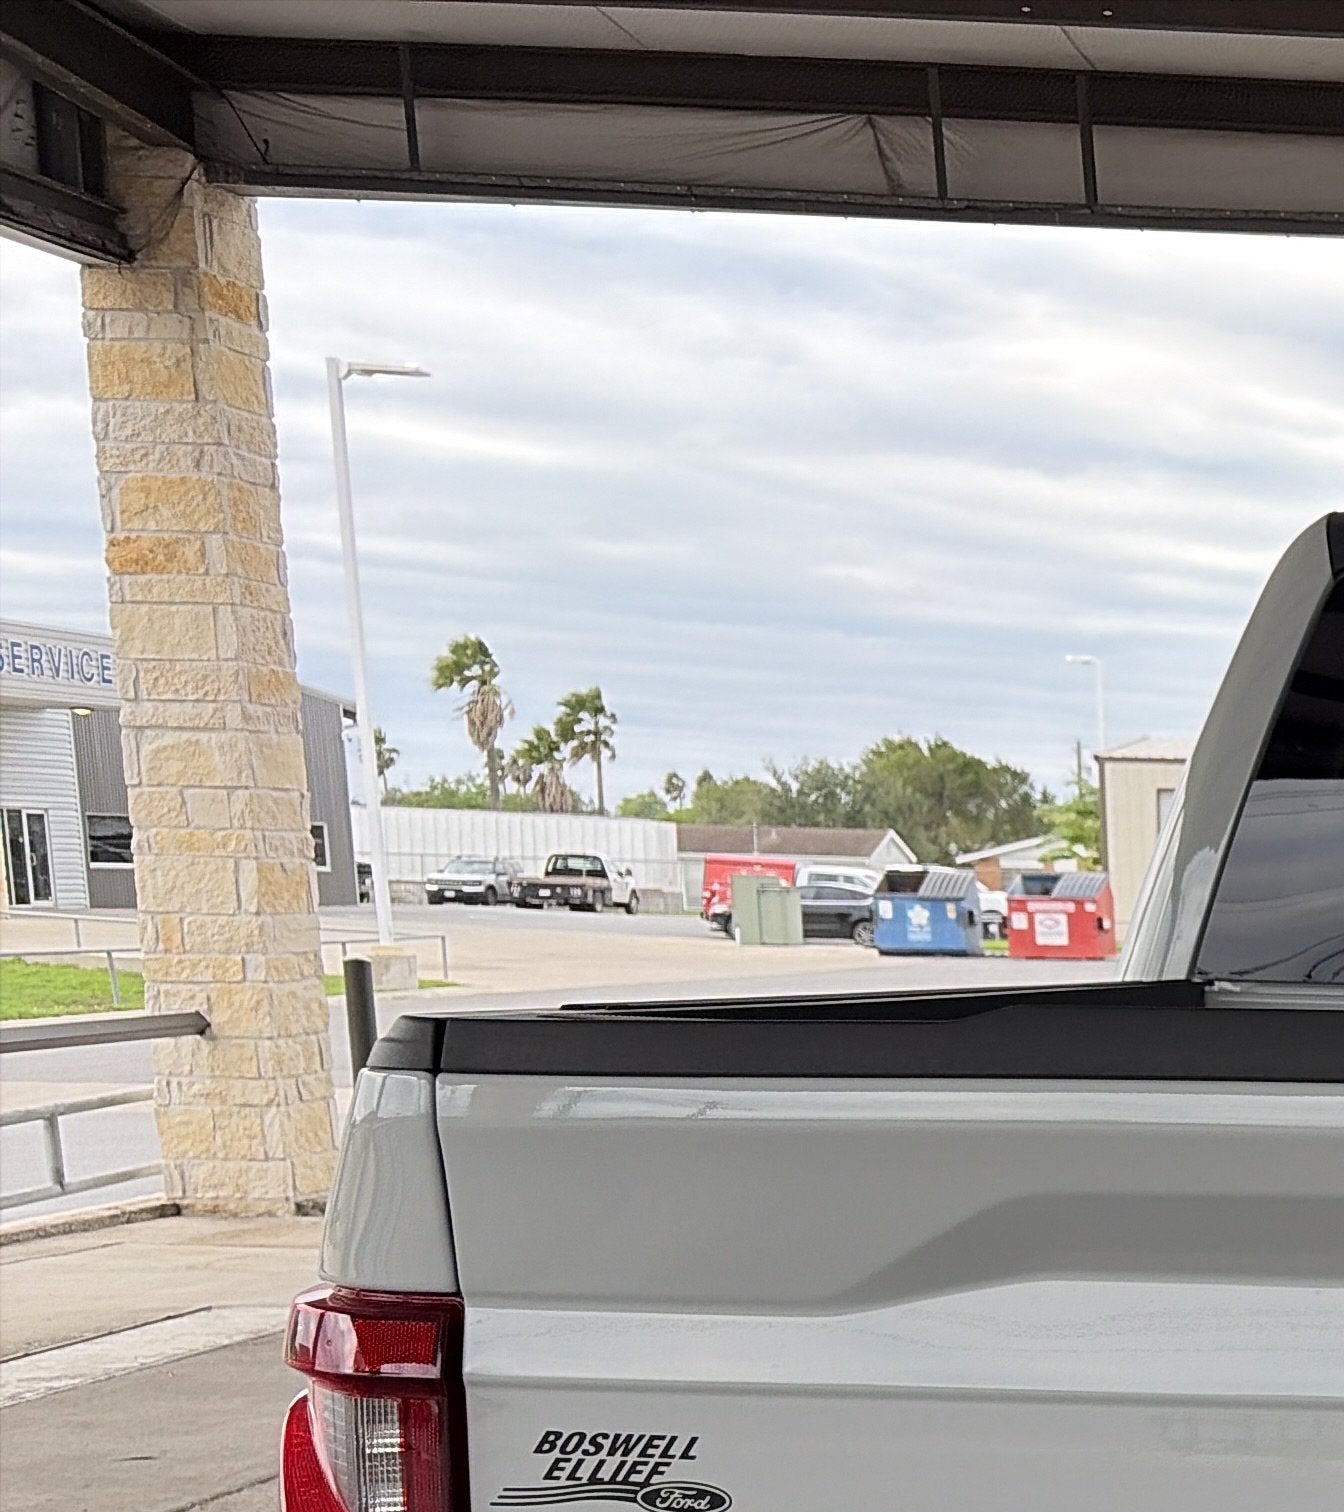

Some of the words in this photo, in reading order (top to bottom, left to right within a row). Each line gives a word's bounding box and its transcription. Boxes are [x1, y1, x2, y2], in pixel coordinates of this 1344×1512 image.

[532, 1430, 699, 1460] BOSWELL
[542, 1457, 672, 1484] ELLIFF
[655, 1488, 711, 1511] Ford
